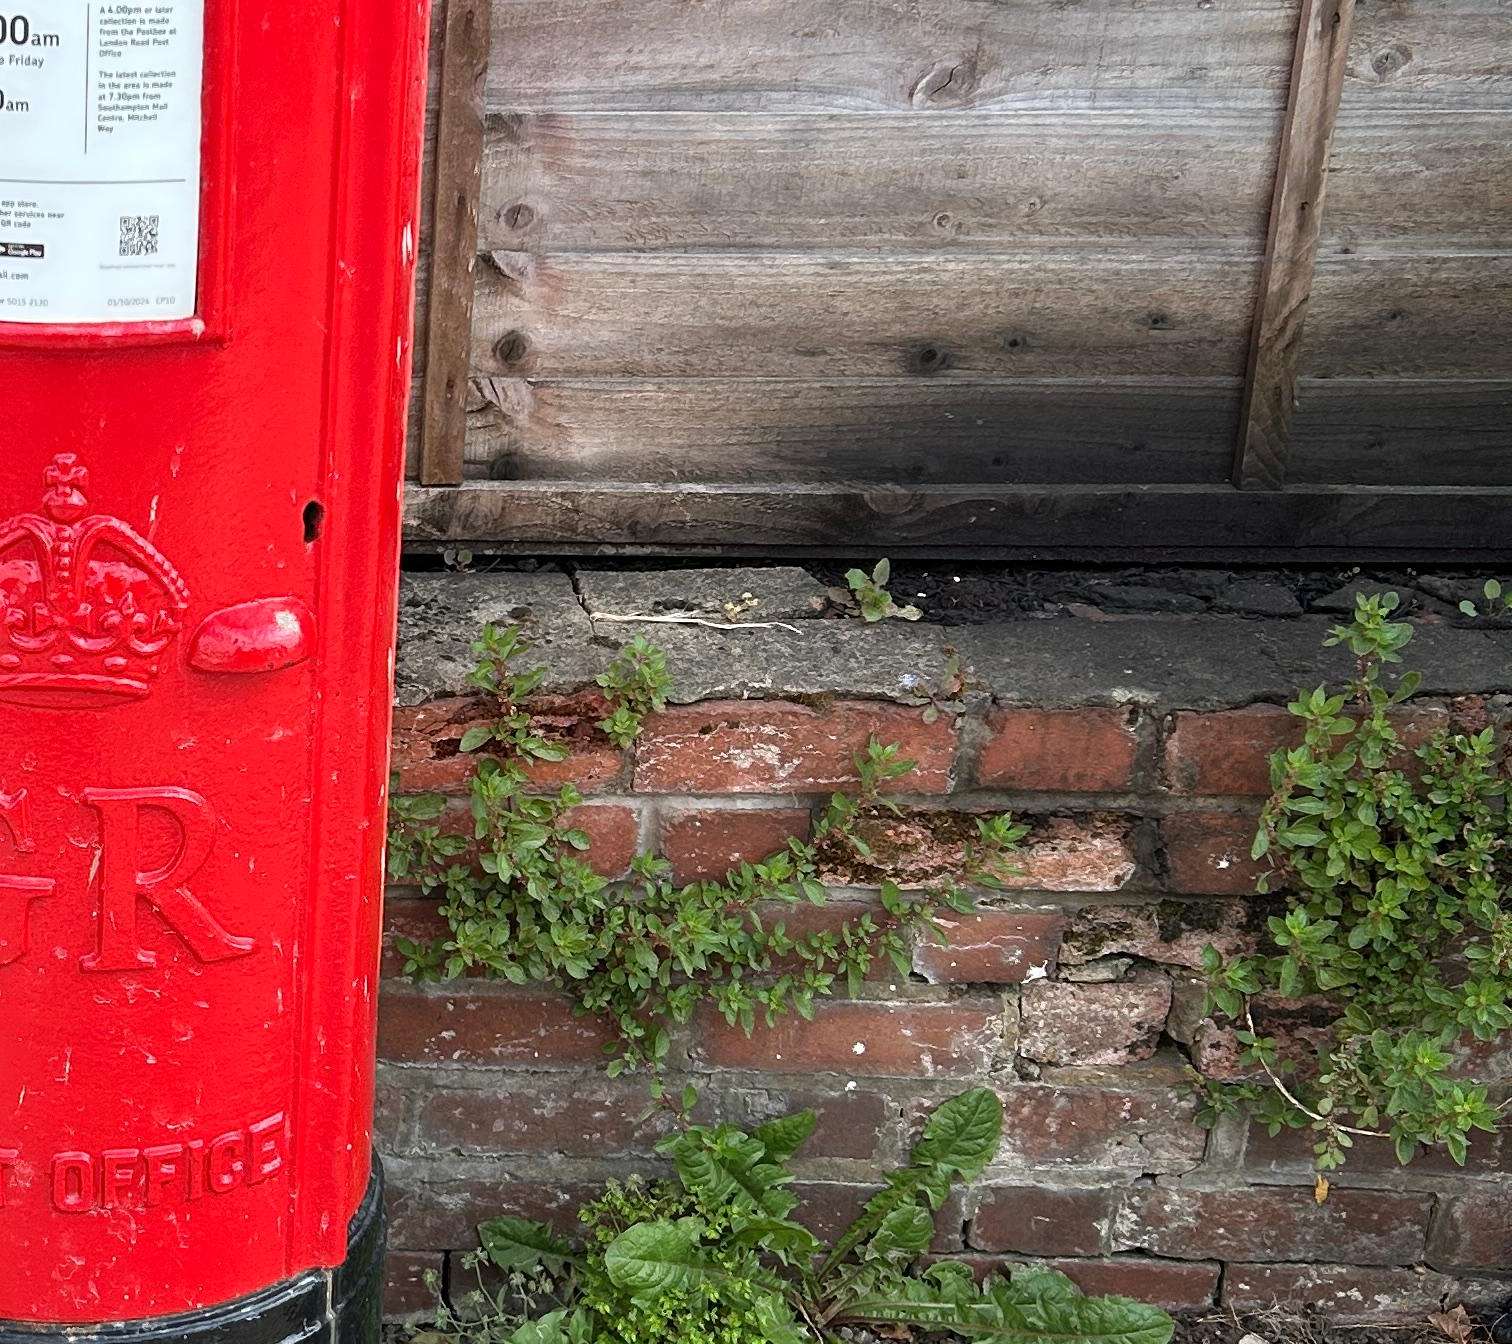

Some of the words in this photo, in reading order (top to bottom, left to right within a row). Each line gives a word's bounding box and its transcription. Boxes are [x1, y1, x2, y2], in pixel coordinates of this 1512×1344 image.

[99, 17, 137, 25] collection
[148, 17, 170, 25] made
[99, 27, 118, 36] from
[120, 28, 134, 36] the
[8, 54, 45, 69] Friday
[98, 70, 114, 78] The
[108, 81, 121, 89] the
[49, 1109, 285, 1214] OFFICE
